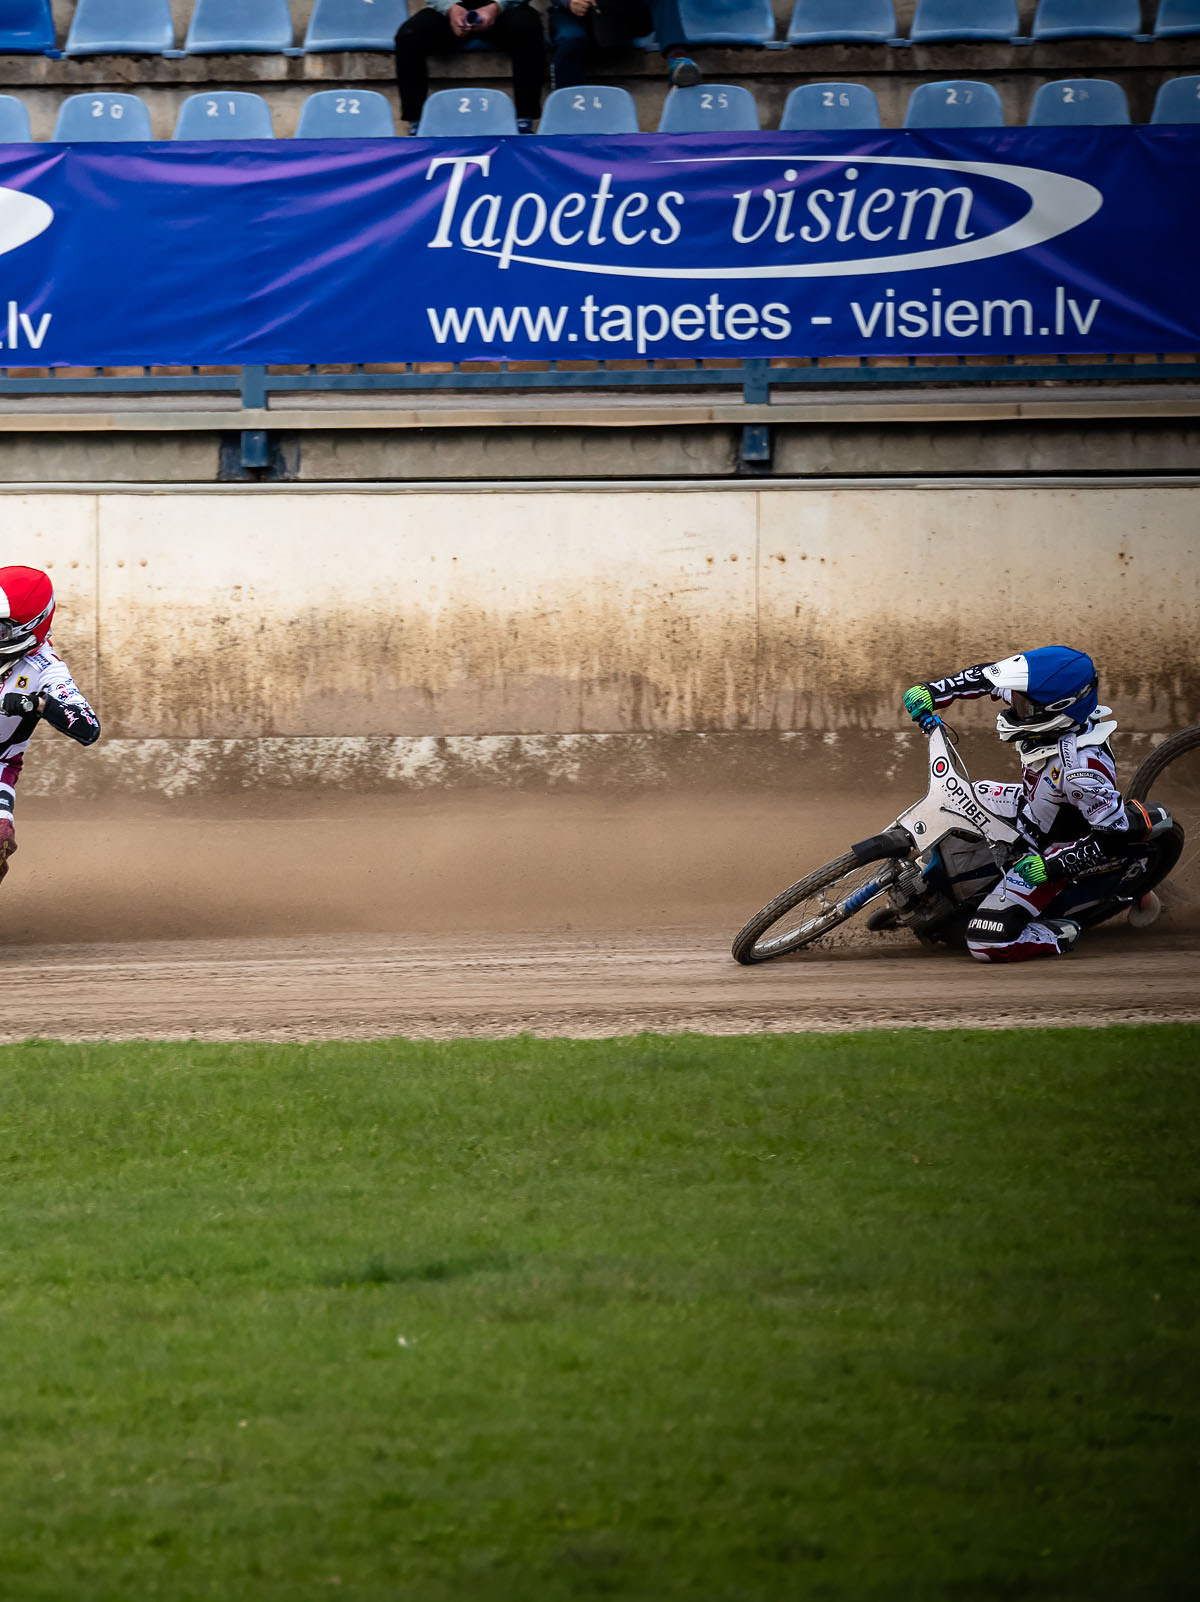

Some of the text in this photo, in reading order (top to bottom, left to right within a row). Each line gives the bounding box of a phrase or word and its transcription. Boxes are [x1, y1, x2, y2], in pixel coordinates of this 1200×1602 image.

[335, 97, 361, 115] 22
[458, 97, 489, 114] 23
[572, 94, 603, 111] 24
[700, 93, 729, 110] 25
[822, 91, 850, 108] 26
[945, 88, 973, 106] 27
[91, 101, 124, 120] 20
[206, 101, 236, 117] 21
[425, 154, 976, 269] Tapetes visiem
[427, 286, 1099, 354] www.tapetes - visiem.lv
[945, 776, 991, 828] OPTIBET
